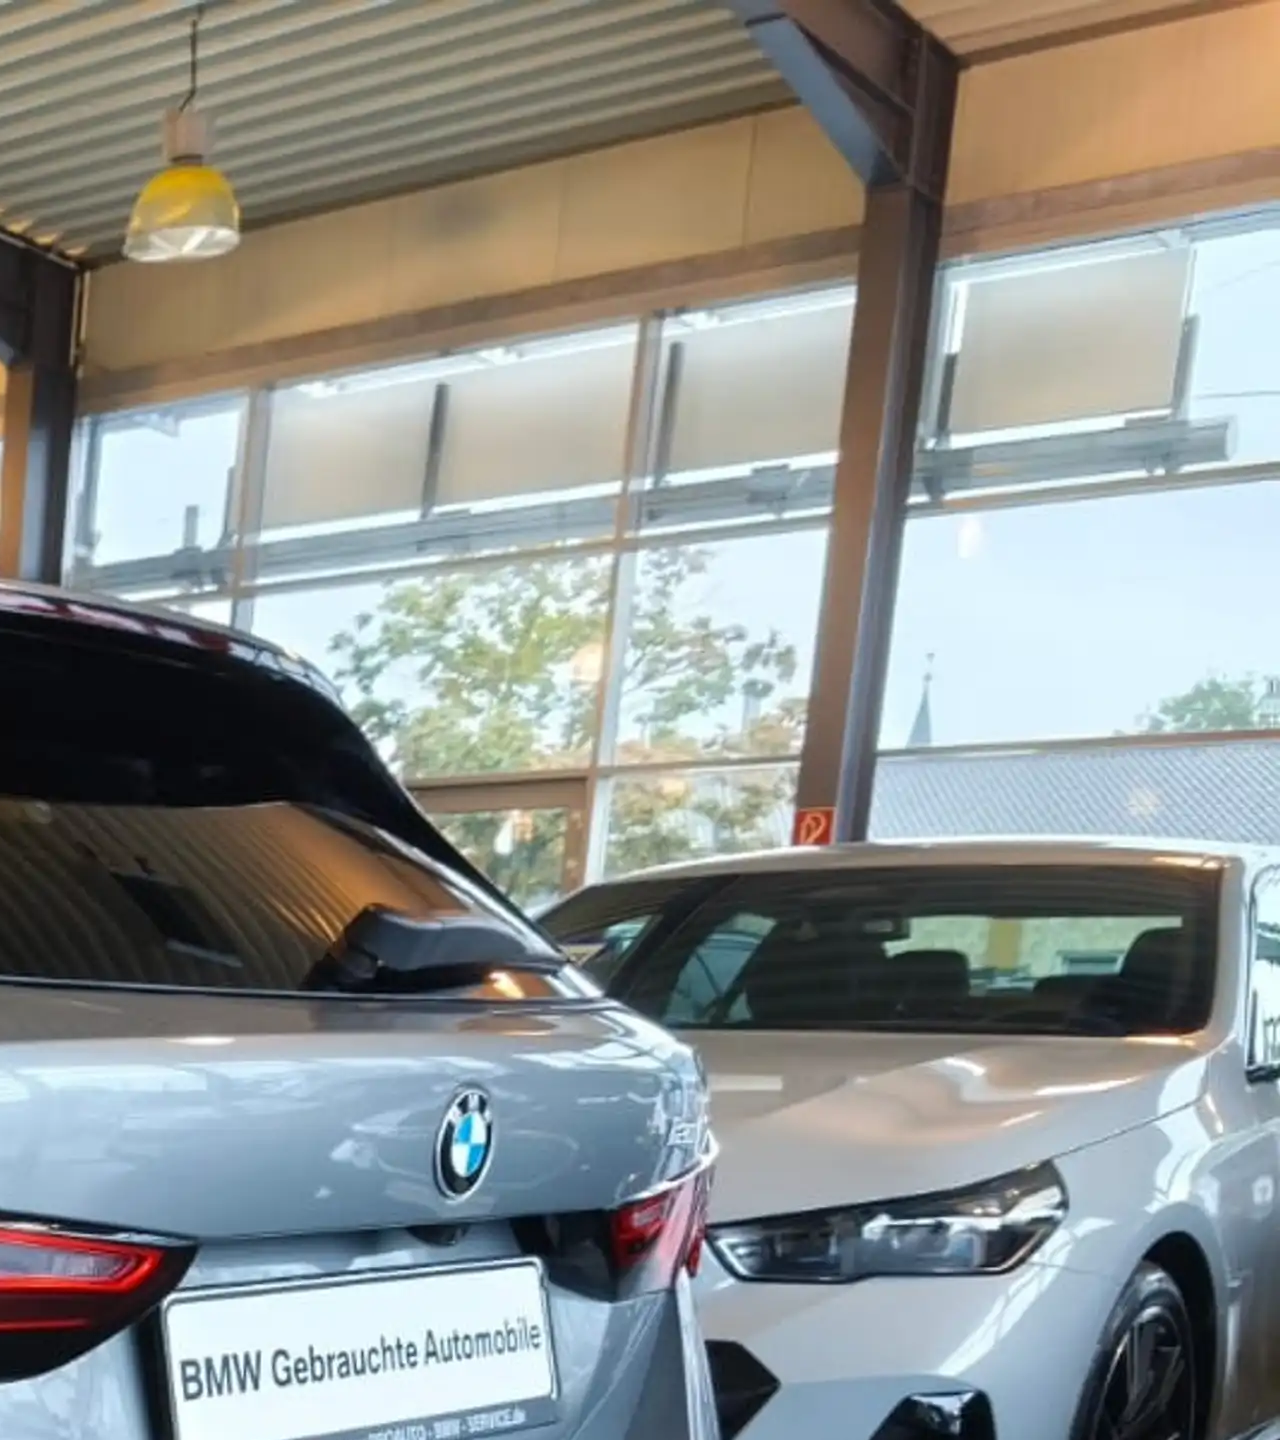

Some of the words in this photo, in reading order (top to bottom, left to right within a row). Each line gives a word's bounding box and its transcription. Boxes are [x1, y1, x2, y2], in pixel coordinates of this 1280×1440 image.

[180, 1350, 262, 1402] BMW
[271, 1333, 419, 1388] Gebrauchte
[422, 1317, 542, 1365] Automobile
